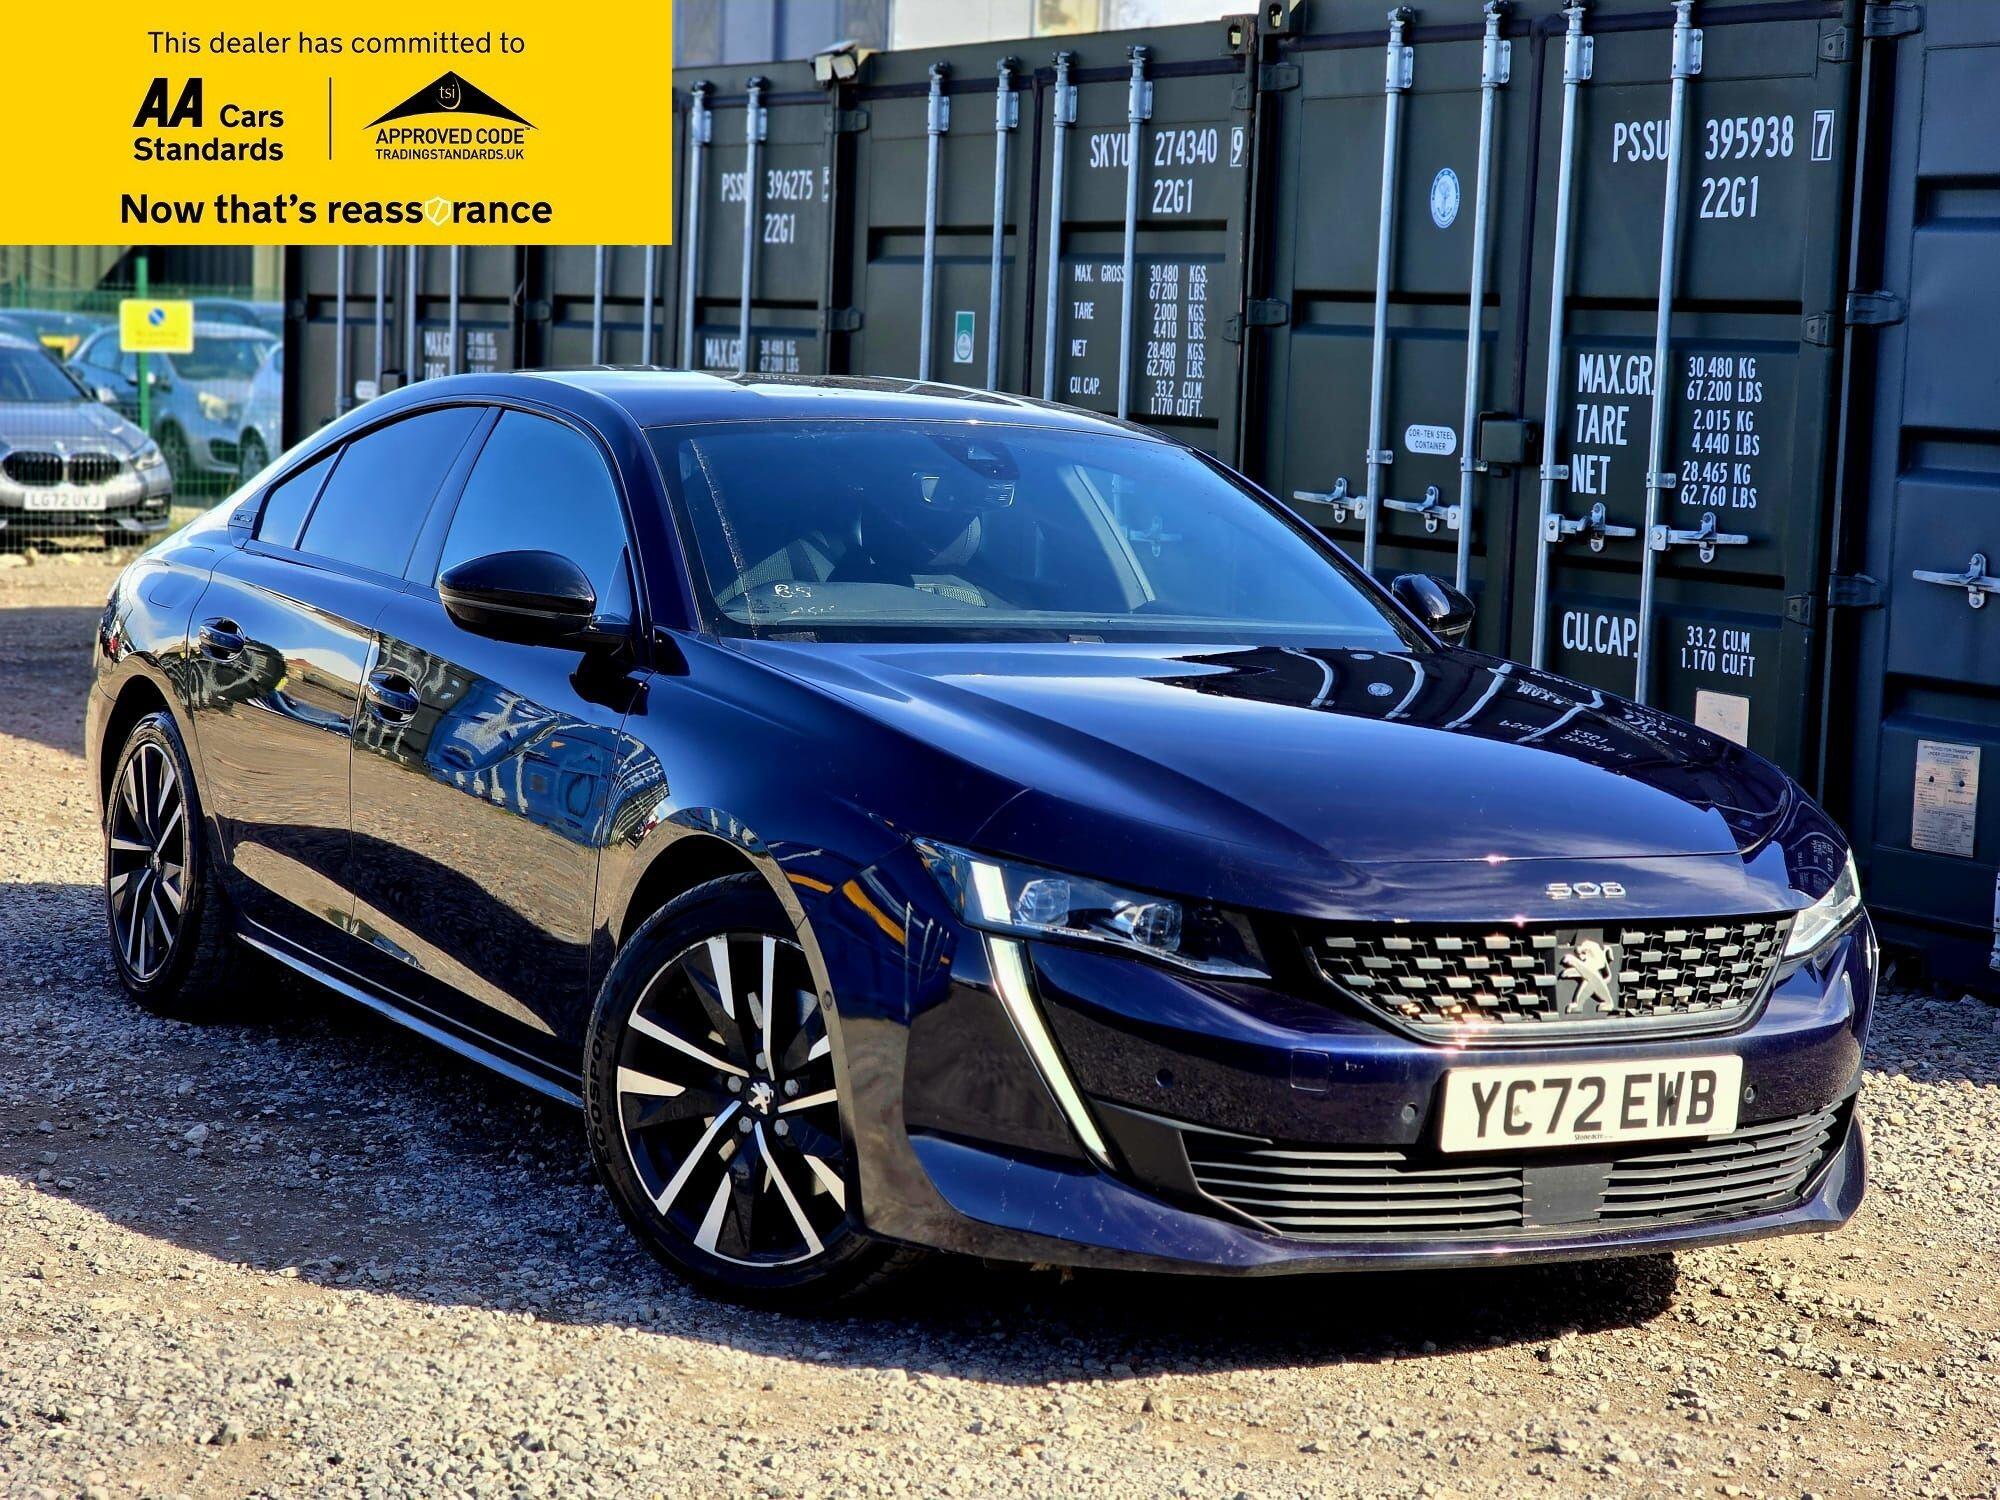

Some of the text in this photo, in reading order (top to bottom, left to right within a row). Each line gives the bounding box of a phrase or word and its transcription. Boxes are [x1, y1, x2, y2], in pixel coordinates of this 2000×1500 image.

[1154, 128, 1218, 167] 274340
[1612, 119, 1671, 163] PSSU
[1705, 114, 1794, 161] 395938
[766, 169, 814, 201] 396275
[1152, 179, 1194, 213] 22G1
[1700, 175, 1759, 218] 22G1
[763, 213, 796, 243] 22G1
[1074, 302, 1095, 320] TARE
[1071, 339, 1088, 358] NET
[1738, 357, 1756, 379] KG
[1738, 381, 1763, 403] LBS
[1576, 403, 1629, 445] TARE
[1736, 410, 1754, 432] KG
[1415, 440, 1446, 450] CONTAINER
[1436, 430, 1453, 440] STEEL
[1735, 433, 1760, 456] LBS
[1571, 454, 1611, 495] NET
[1733, 463, 1751, 485] KG
[1732, 486, 1757, 509] LBS
[1686, 625, 1750, 653] 33.2 CU.M
[1721, 652, 1756, 677] CU.FT
[1545, 882, 1627, 900] 508
[1471, 1069, 1718, 1138] YC72 EWB
